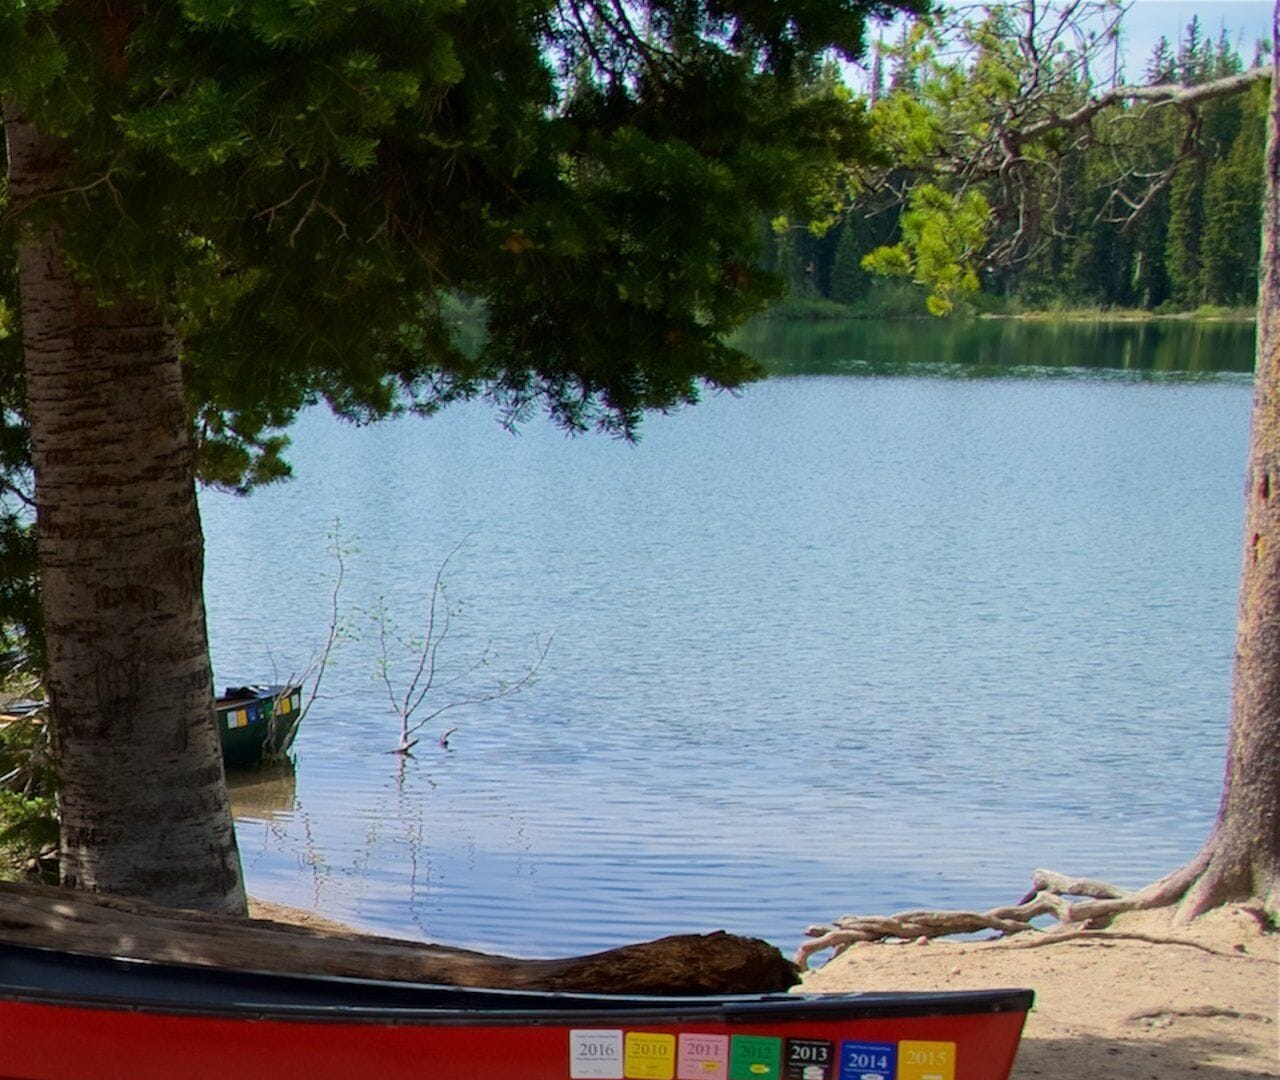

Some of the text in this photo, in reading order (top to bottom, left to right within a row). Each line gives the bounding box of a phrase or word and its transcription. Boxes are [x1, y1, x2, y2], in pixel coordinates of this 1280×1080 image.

[580, 1042, 615, 1057] 2016
[632, 1042, 668, 1057] 2010
[687, 1042, 720, 1056] 2011
[791, 1045, 828, 1062] 2013
[848, 1052, 888, 1070] 2014
[906, 1049, 948, 1066] 2015
